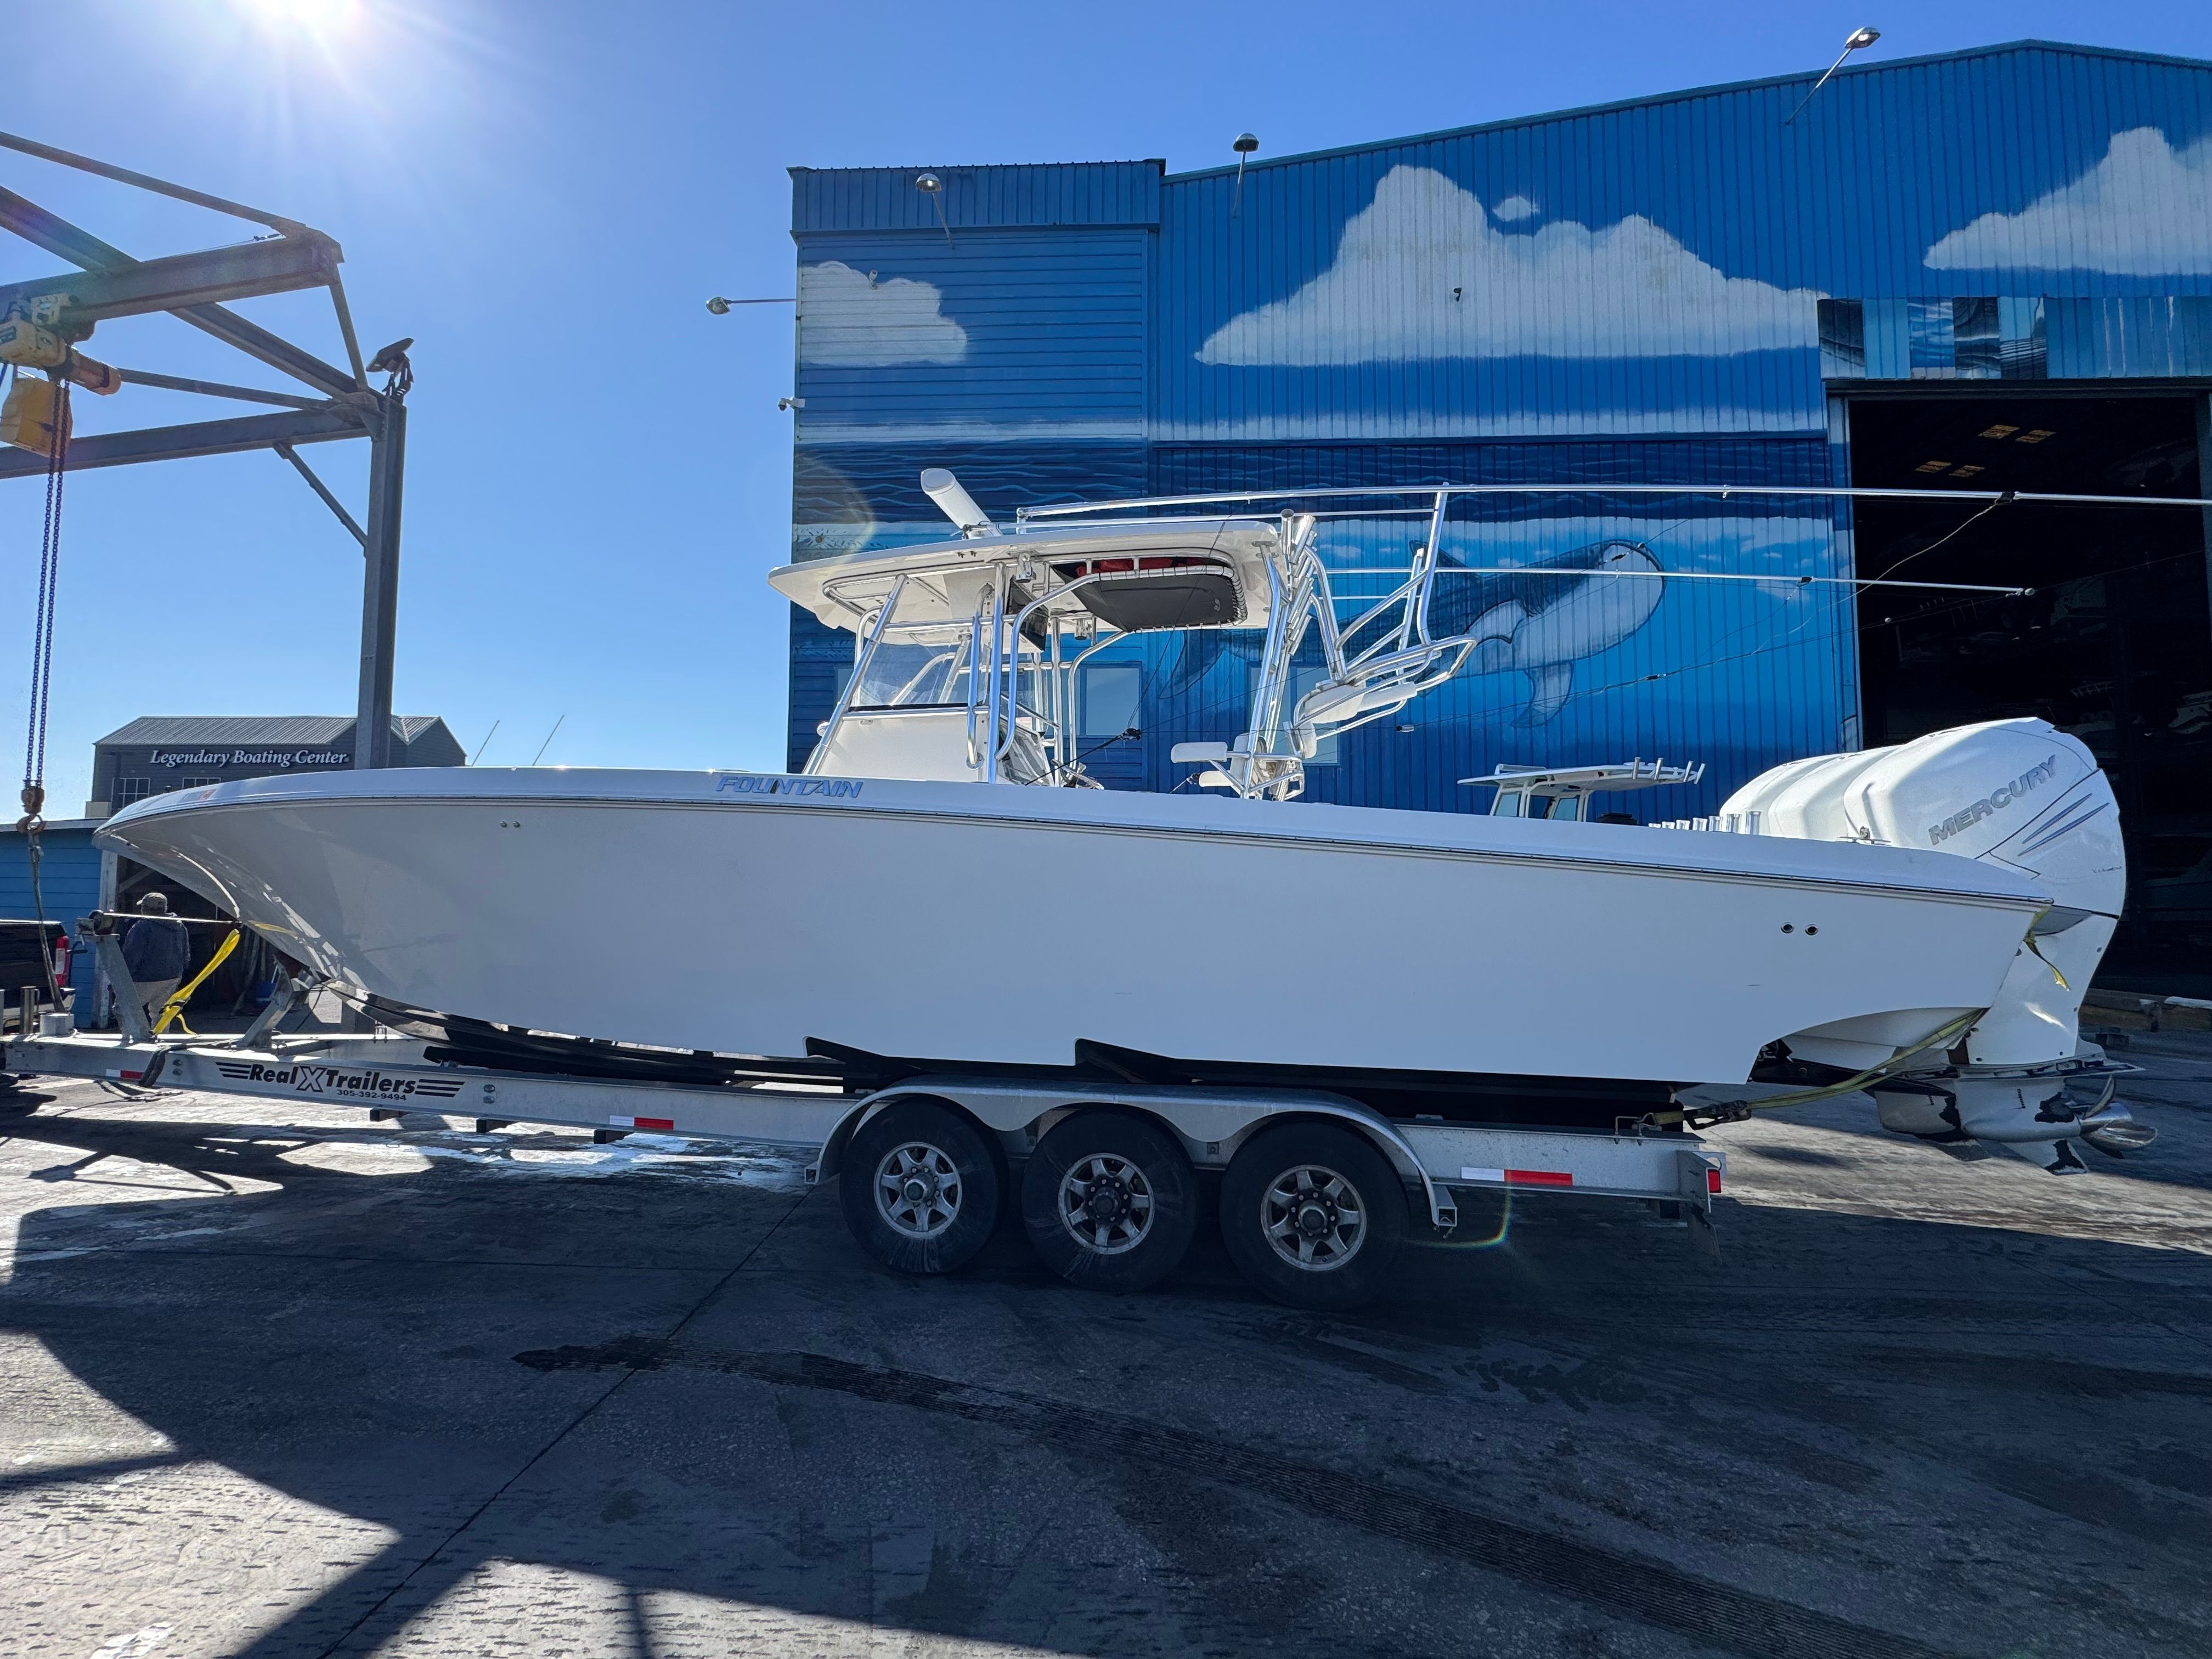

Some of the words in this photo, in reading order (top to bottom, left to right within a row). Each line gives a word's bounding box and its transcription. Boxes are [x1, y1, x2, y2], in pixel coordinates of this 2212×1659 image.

[150, 749, 230, 768] Legendary
[232, 750, 291, 768] Boating
[295, 749, 347, 764] Center
[715, 776, 863, 798] FOUNTAIN
[1928, 754, 2056, 845] MERCURY
[337, 1089, 407, 1101] 305-392-9494
